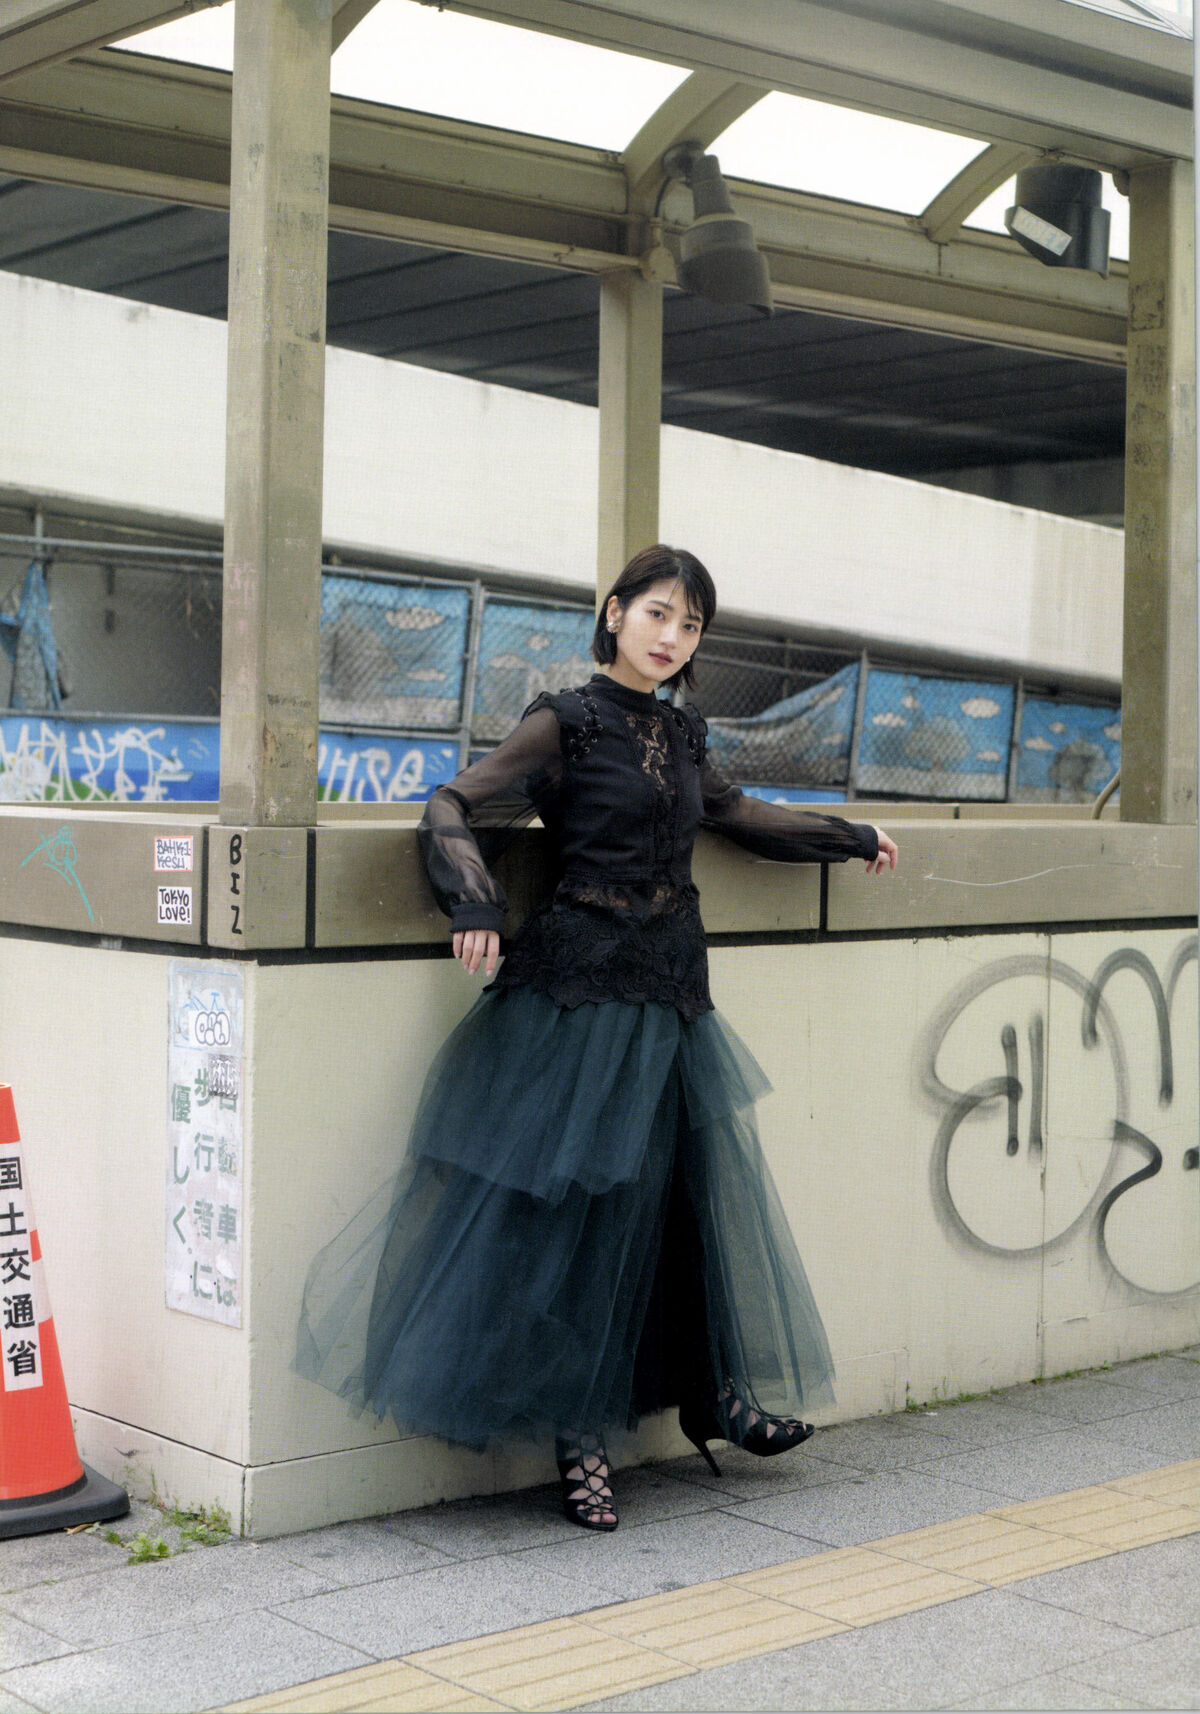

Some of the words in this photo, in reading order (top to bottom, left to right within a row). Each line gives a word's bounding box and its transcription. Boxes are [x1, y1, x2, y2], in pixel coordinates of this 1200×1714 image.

[0, 1156, 37, 1377] 国土交通省
